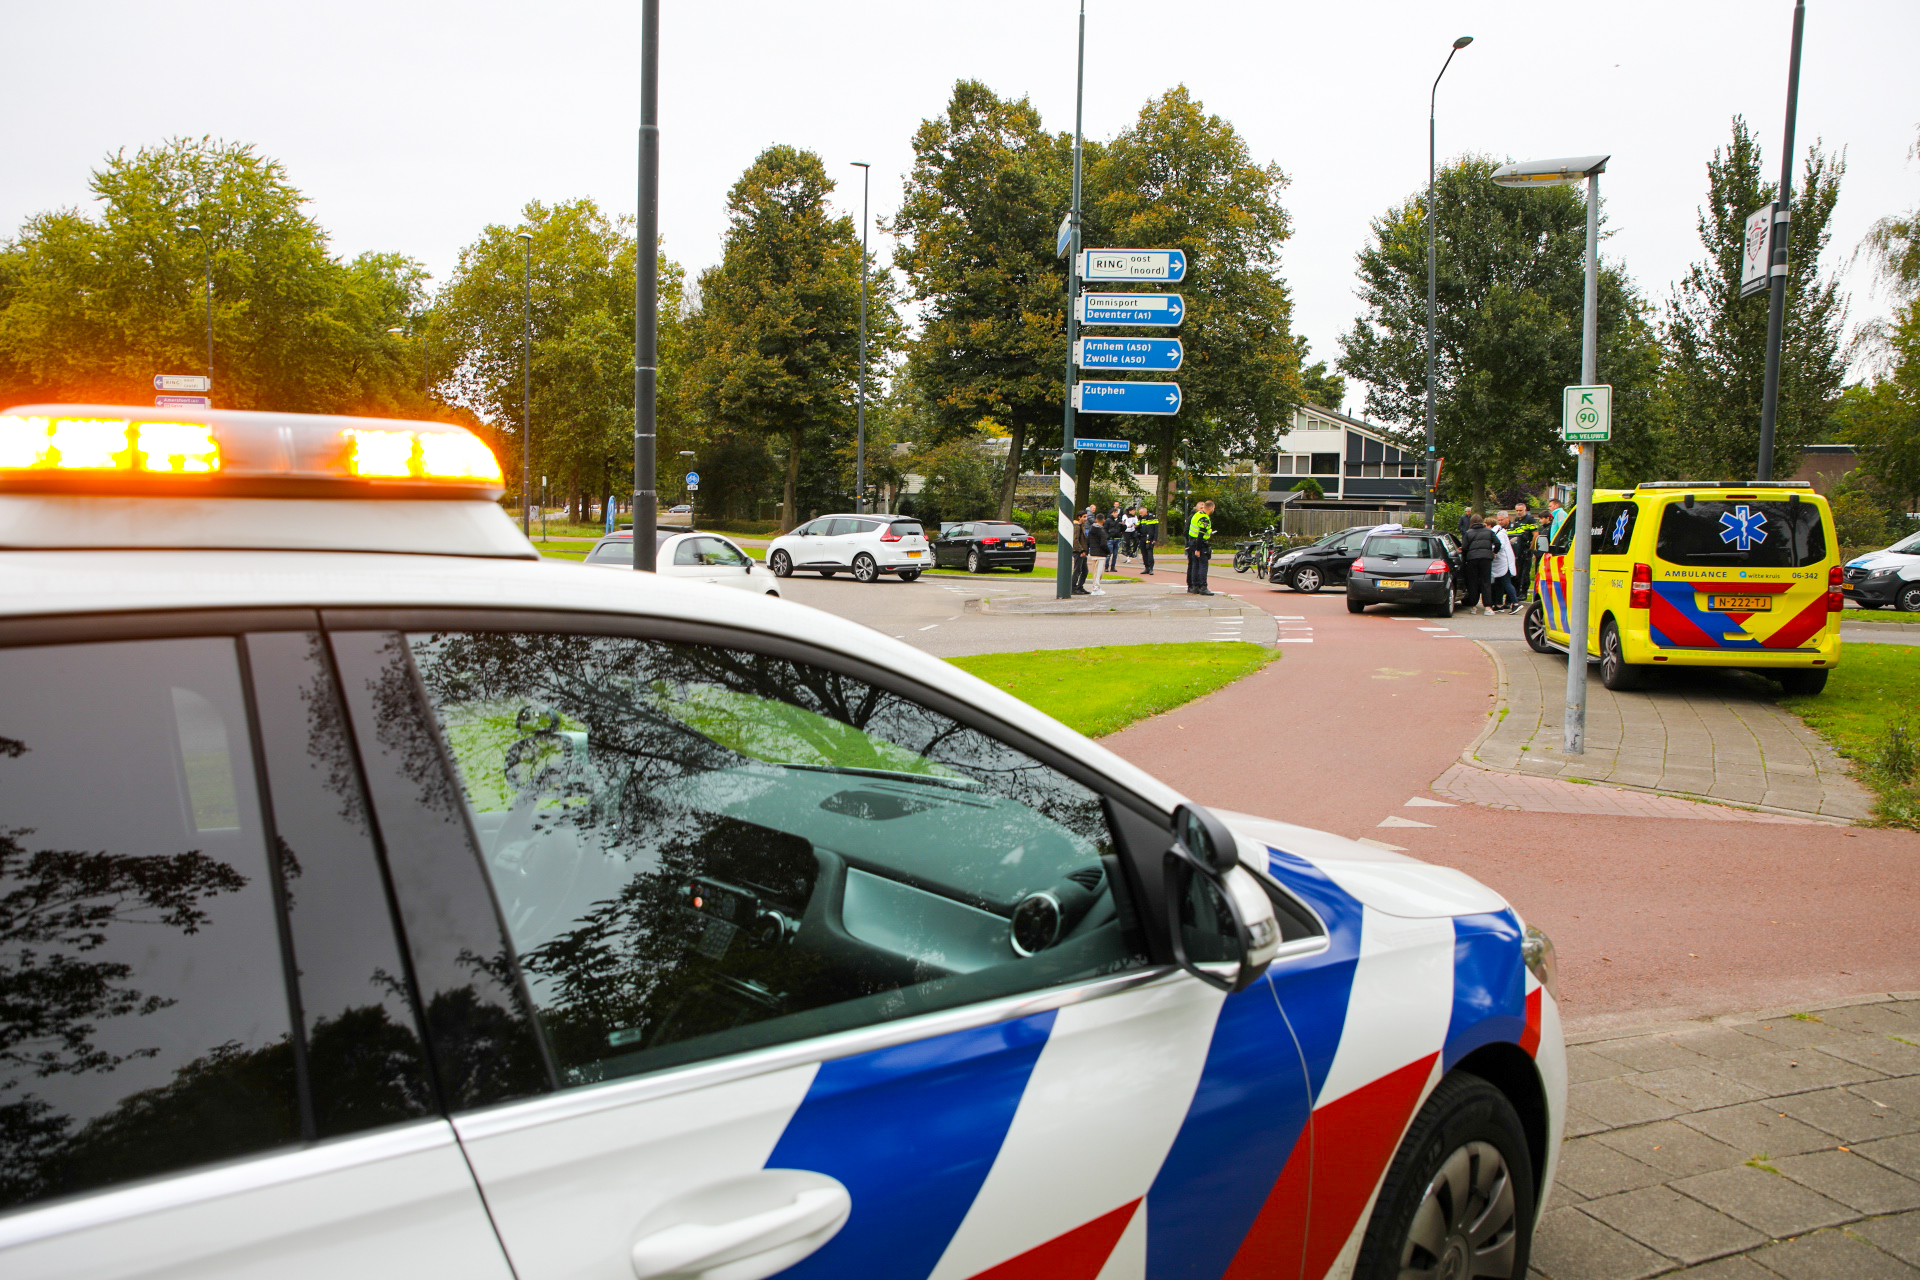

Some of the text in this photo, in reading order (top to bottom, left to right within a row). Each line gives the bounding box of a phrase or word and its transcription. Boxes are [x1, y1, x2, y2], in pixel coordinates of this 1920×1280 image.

[1130, 255, 1151, 263] oost
[1096, 260, 1124, 269] RING
[1130, 265, 1165, 275] (noord)
[1089, 298, 1138, 308] Omnisport
[1086, 309, 1152, 320] Deventer (A1)
[1085, 341, 1152, 352] Arnhem (A50)
[1085, 354, 1146, 364] Zwolle (A50)
[1084, 386, 1125, 396] Zutphen
[1580, 413, 1596, 422] 90
[1664, 570, 1728, 578] AMBULANCE
[1719, 597, 1767, 607] N-222-TJ
